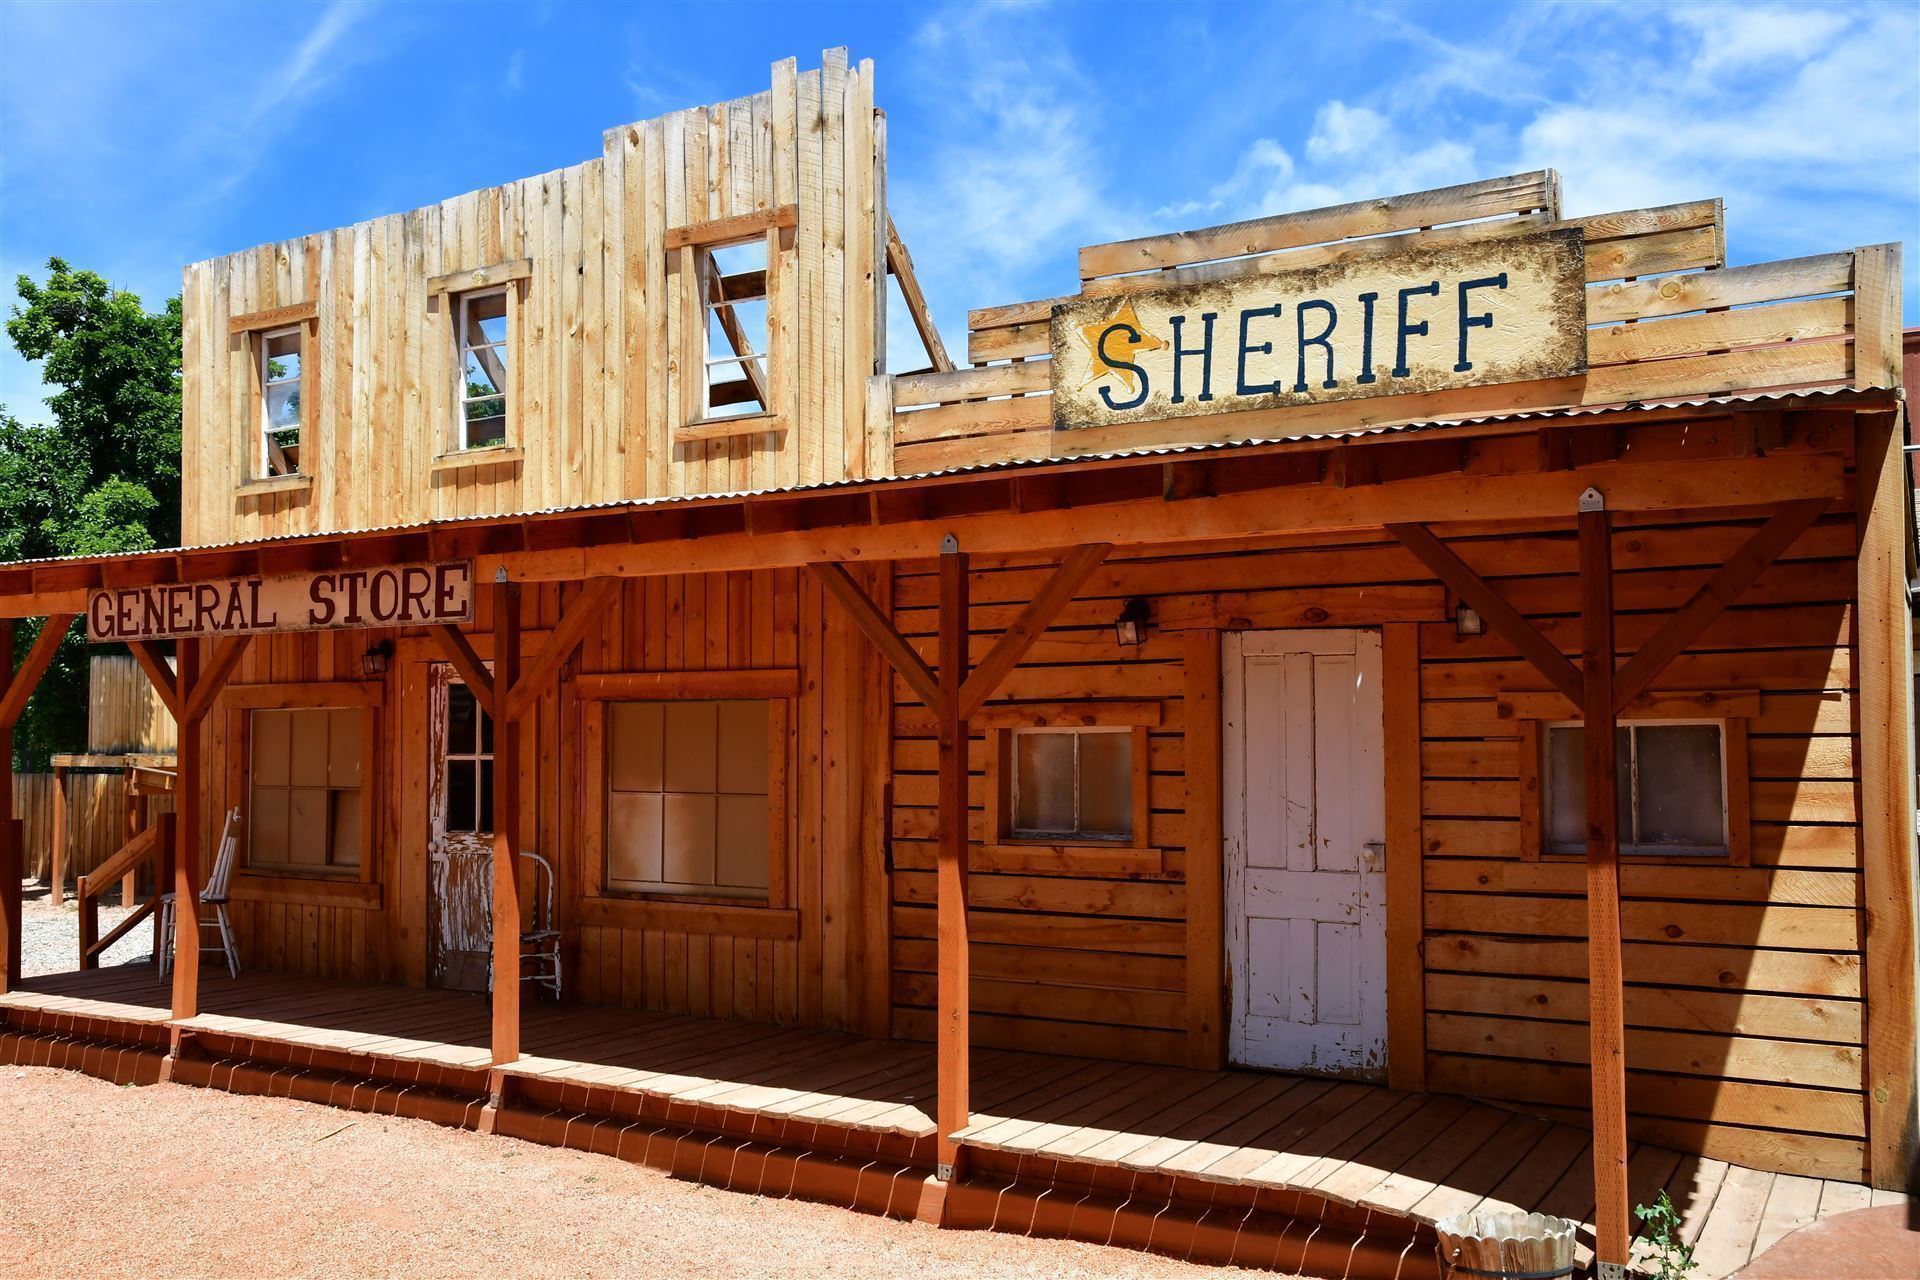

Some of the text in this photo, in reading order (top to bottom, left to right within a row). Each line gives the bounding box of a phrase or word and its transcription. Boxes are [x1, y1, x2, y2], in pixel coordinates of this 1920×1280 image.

[1098, 273, 1508, 410] SHERIFF
[92, 564, 469, 638] GENERAL STORE
